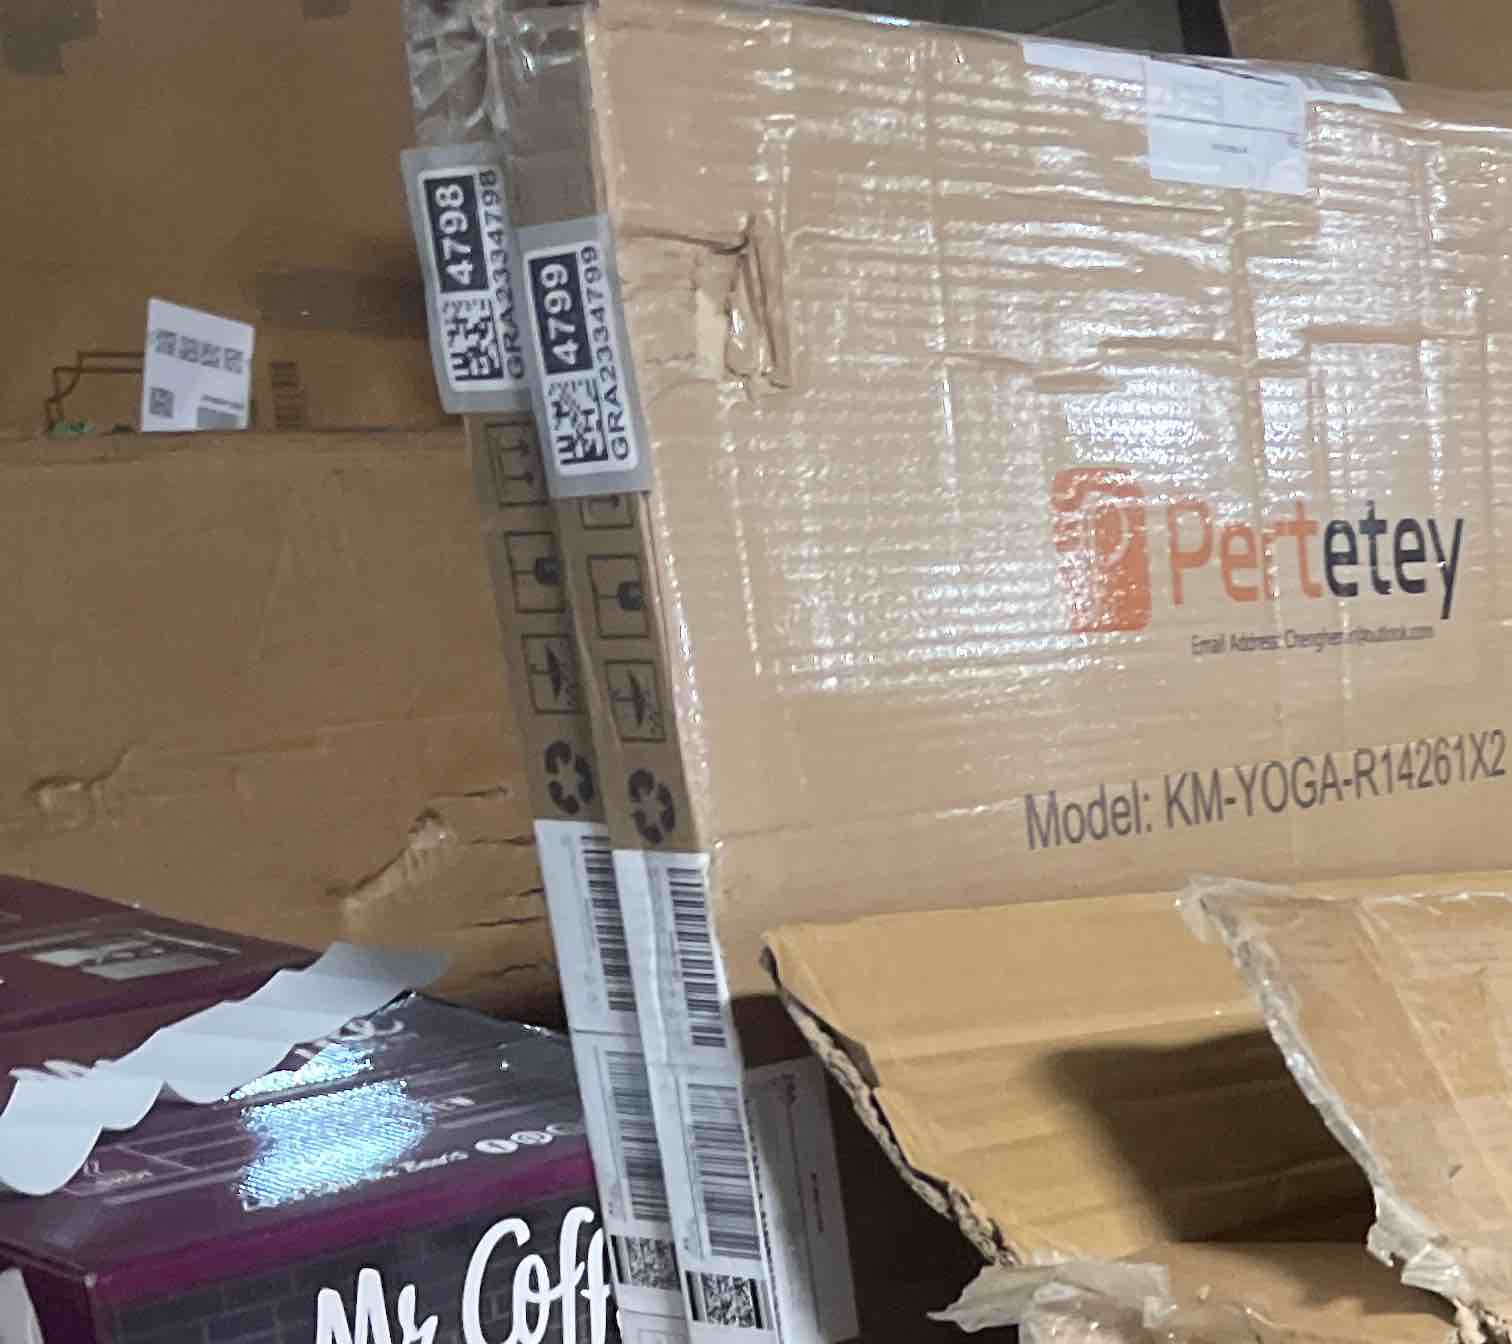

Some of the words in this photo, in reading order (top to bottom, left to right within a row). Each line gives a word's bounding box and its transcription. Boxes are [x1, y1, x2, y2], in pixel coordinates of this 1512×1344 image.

[435, 184, 473, 286] 4798
[540, 263, 578, 365] 4799
[580, 246, 629, 460] GRA2334799
[1168, 499, 1464, 620] Pertetey
[1025, 780, 1152, 850] Model:
[1163, 728, 1507, 829] KM-YOGA-R14261X2
